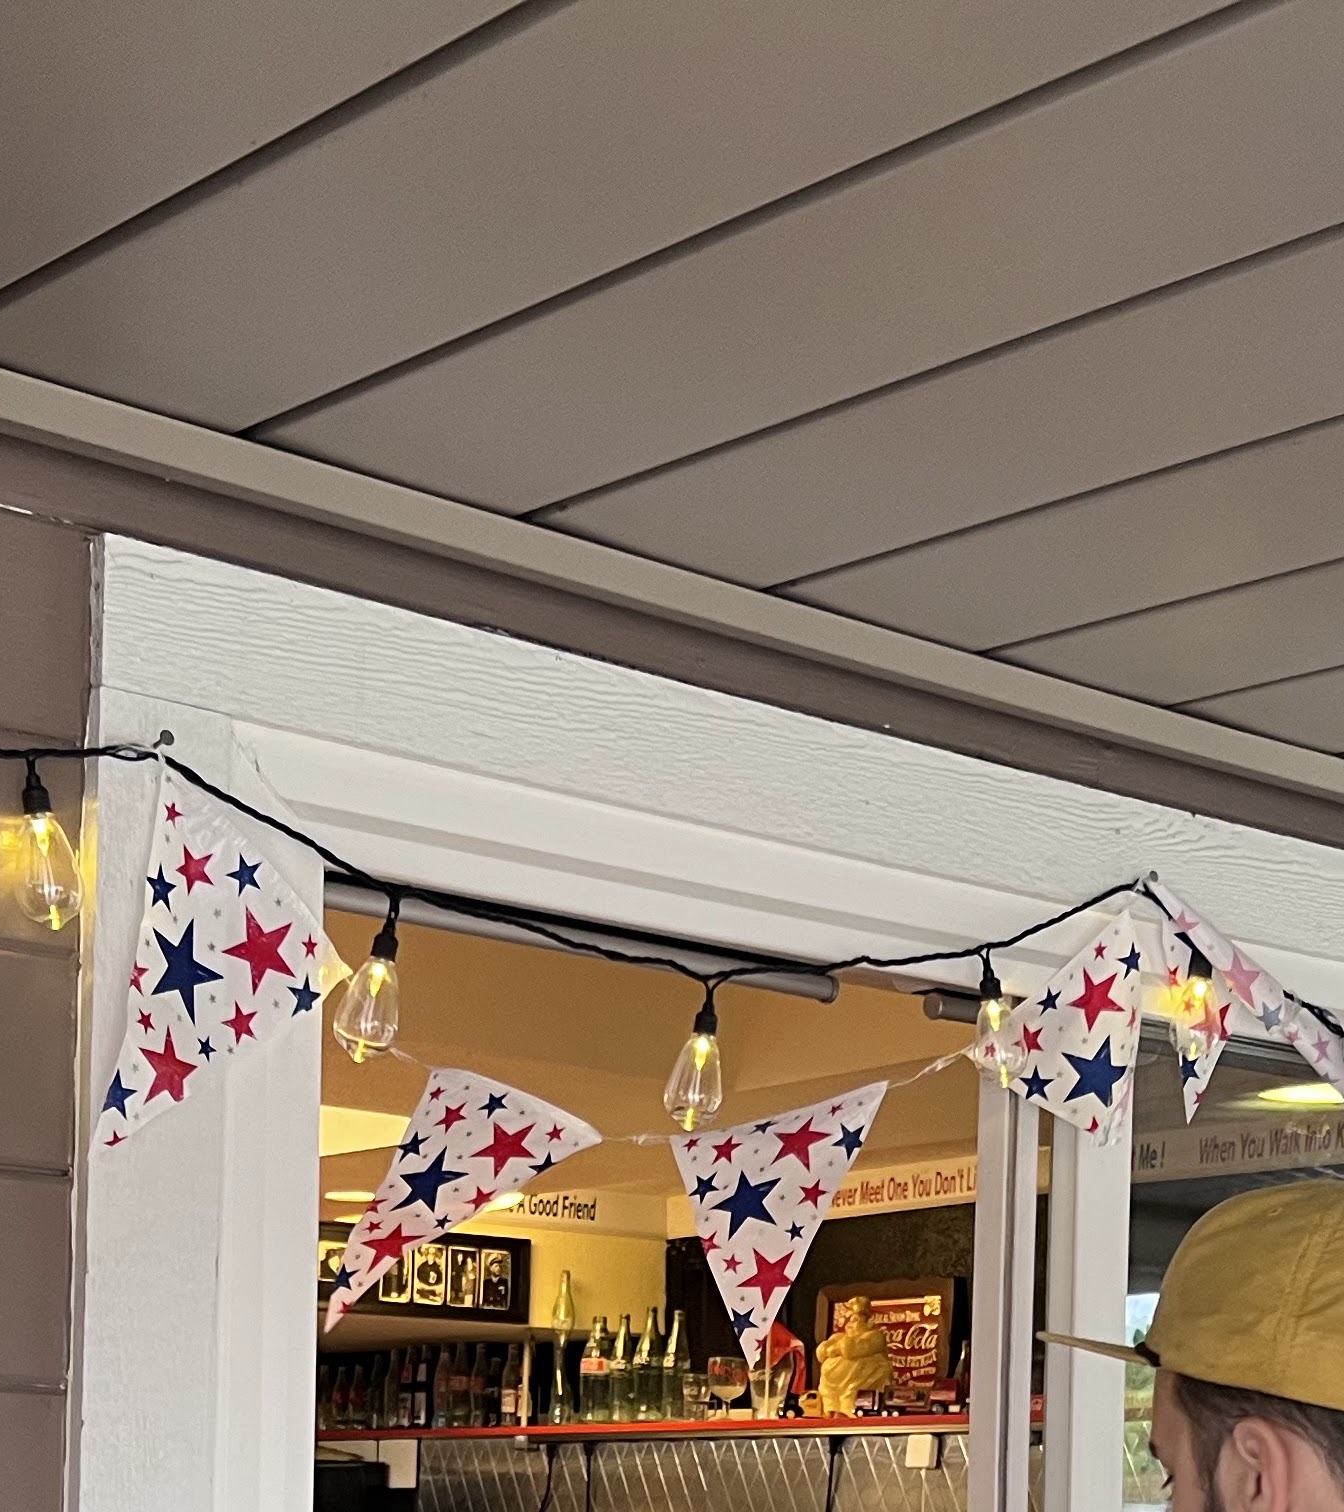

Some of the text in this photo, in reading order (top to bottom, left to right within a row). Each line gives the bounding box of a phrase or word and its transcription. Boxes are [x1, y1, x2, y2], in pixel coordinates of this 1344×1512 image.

[1199, 1136, 1236, 1164] When
[1240, 1133, 1265, 1161] You
[1269, 1124, 1300, 1157] Walk
[860, 1168, 964, 1205] Meet One You Don't
[529, 1194, 558, 1218] Good
[561, 1197, 597, 1222] Friend
